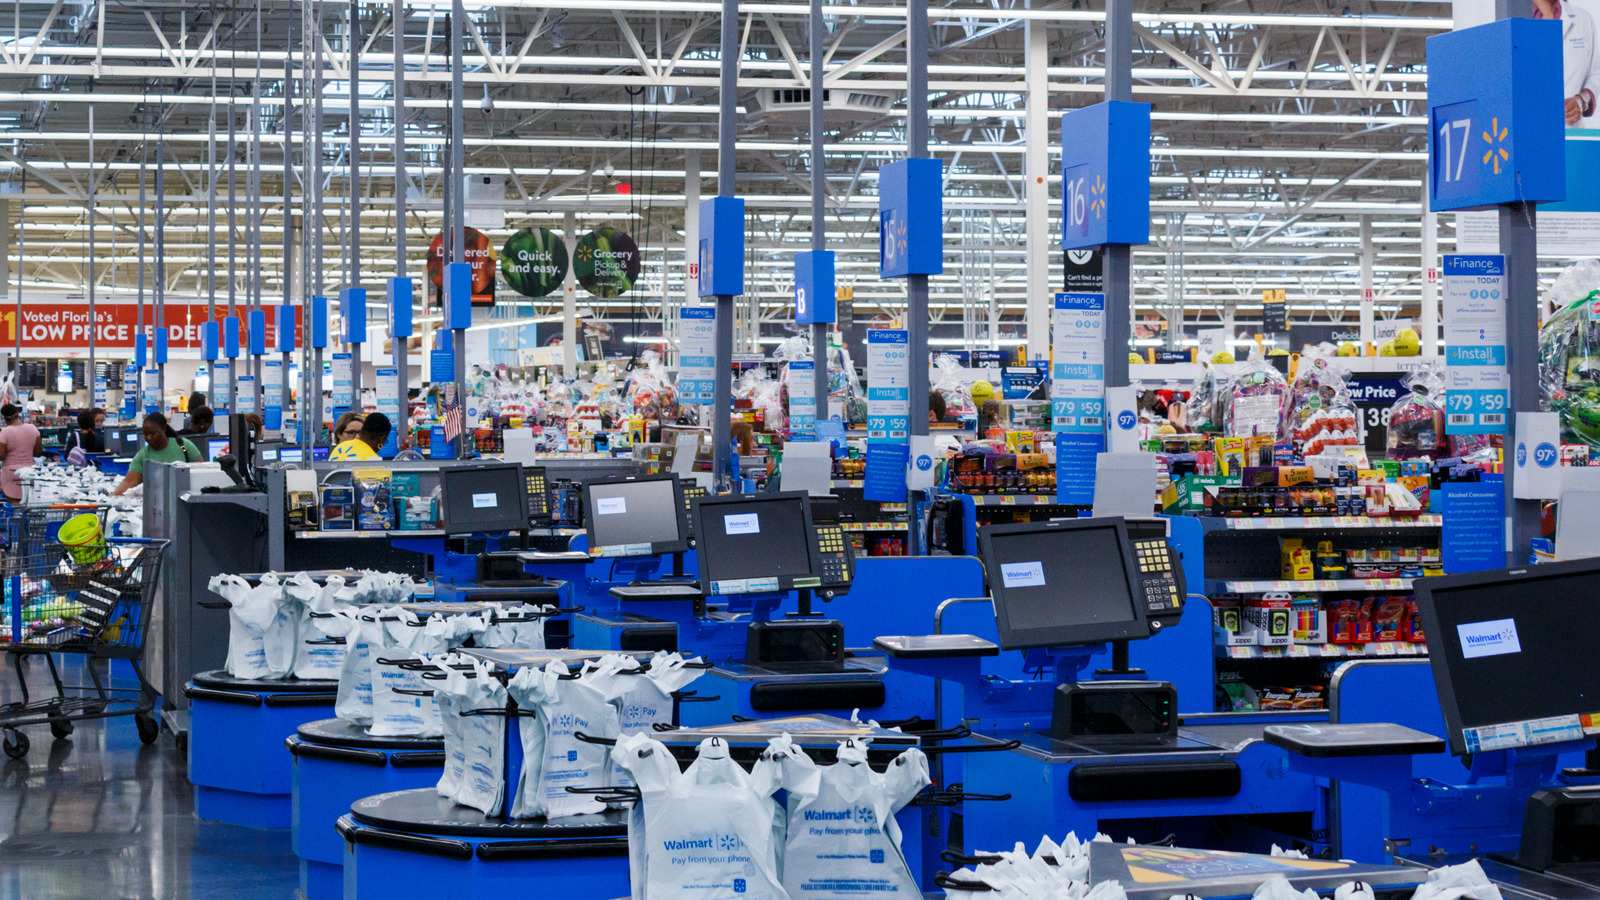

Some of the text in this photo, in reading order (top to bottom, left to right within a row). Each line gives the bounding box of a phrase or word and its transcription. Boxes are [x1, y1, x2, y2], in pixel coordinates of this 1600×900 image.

[1440, 118, 1471, 182] 17
[1068, 177, 1085, 226] 16
[884, 220, 895, 258] 15
[518, 250, 552, 262] Quick
[594, 248, 633, 260] Grocery
[509, 262, 560, 276] and easy.
[1454, 258, 1493, 268] Finance
[594, 268, 627, 278] Delivery
[797, 288, 806, 314] 13
[1063, 295, 1095, 304] Finance
[23, 311, 59, 322] Voted
[0, 311, 16, 340] 1
[22, 325, 128, 340] LOW PRICE
[1458, 347, 1492, 359] Install
[1064, 364, 1093, 374] Install
[681, 382, 713, 391] $79 $59
[1347, 386, 1396, 398] ow Price
[1054, 401, 1101, 414] $79 $59
[1449, 394, 1504, 410] $79 $59
[869, 418, 906, 429] $79 $59
[1466, 632, 1502, 643] Walmart
[643, 707, 656, 717] Pay
[575, 718, 588, 728] Pay
[804, 809, 851, 821] Walmart
[809, 828, 823, 836] Pay
[844, 828, 863, 836] your
[663, 838, 713, 851] Walmart
[672, 857, 686, 865] Pay
